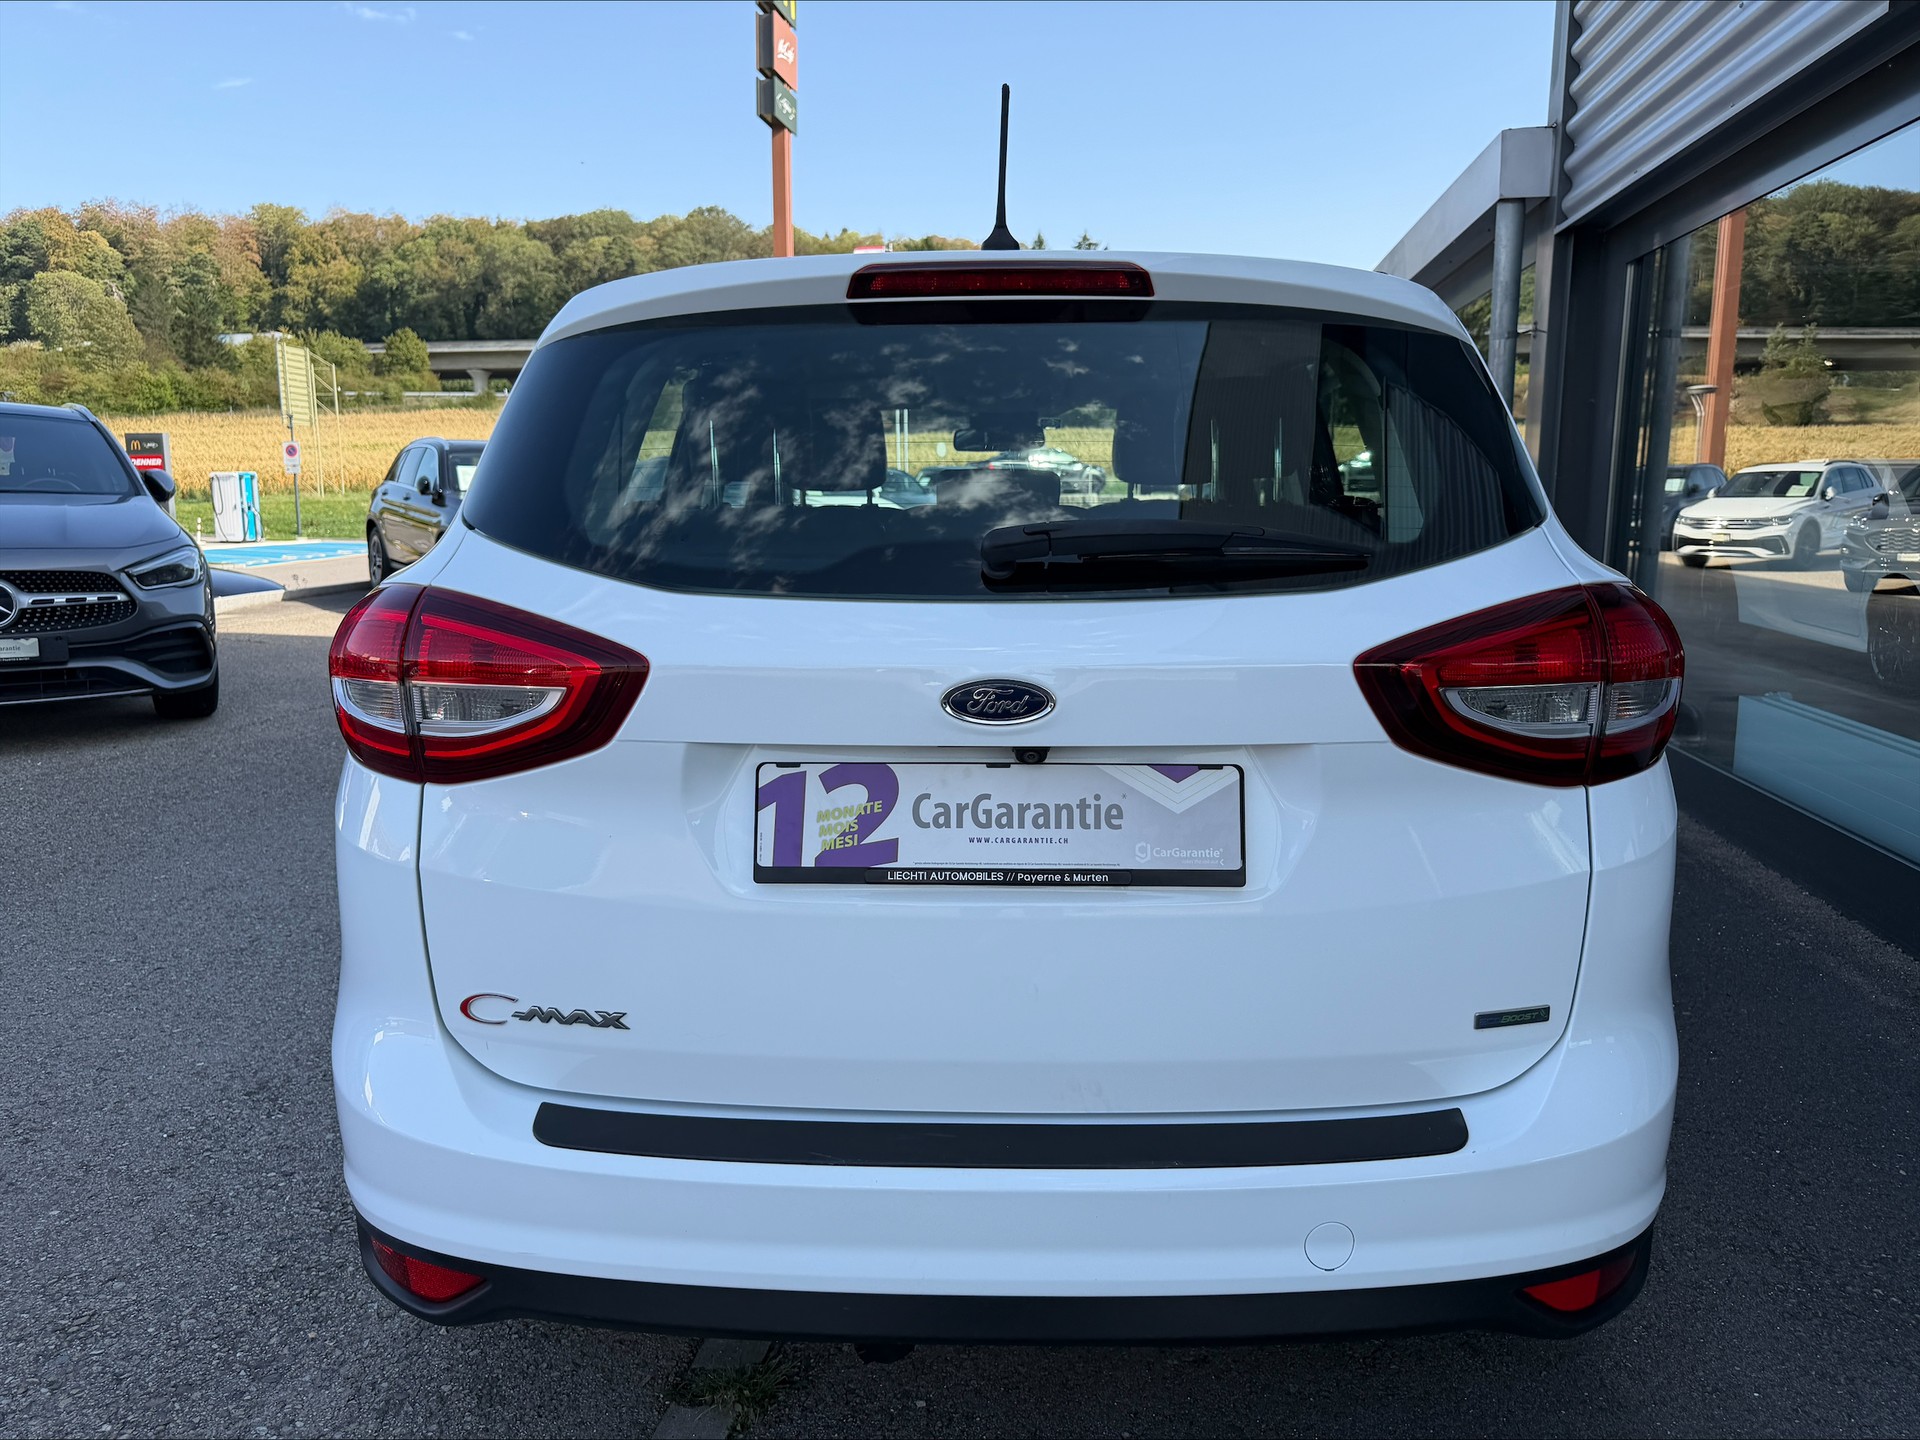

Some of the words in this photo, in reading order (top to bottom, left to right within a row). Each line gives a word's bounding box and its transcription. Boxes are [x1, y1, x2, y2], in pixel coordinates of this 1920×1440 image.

[131, 457, 162, 466] DENNER
[966, 687, 1030, 714] Ford
[758, 763, 900, 867] 12
[816, 800, 883, 823] MONATE
[818, 819, 859, 838] MOIS
[820, 834, 858, 852] MESI
[968, 836, 1069, 845] WWW.CARGARANTIE.CH
[887, 870, 928, 882] LIECHTI
[930, 870, 1004, 882] AUTOMOBILES
[1017, 872, 1061, 884] Payerne
[1063, 872, 1071, 882] &
[1073, 872, 1109, 882] Murten
[459, 992, 631, 1030] C-MAX
